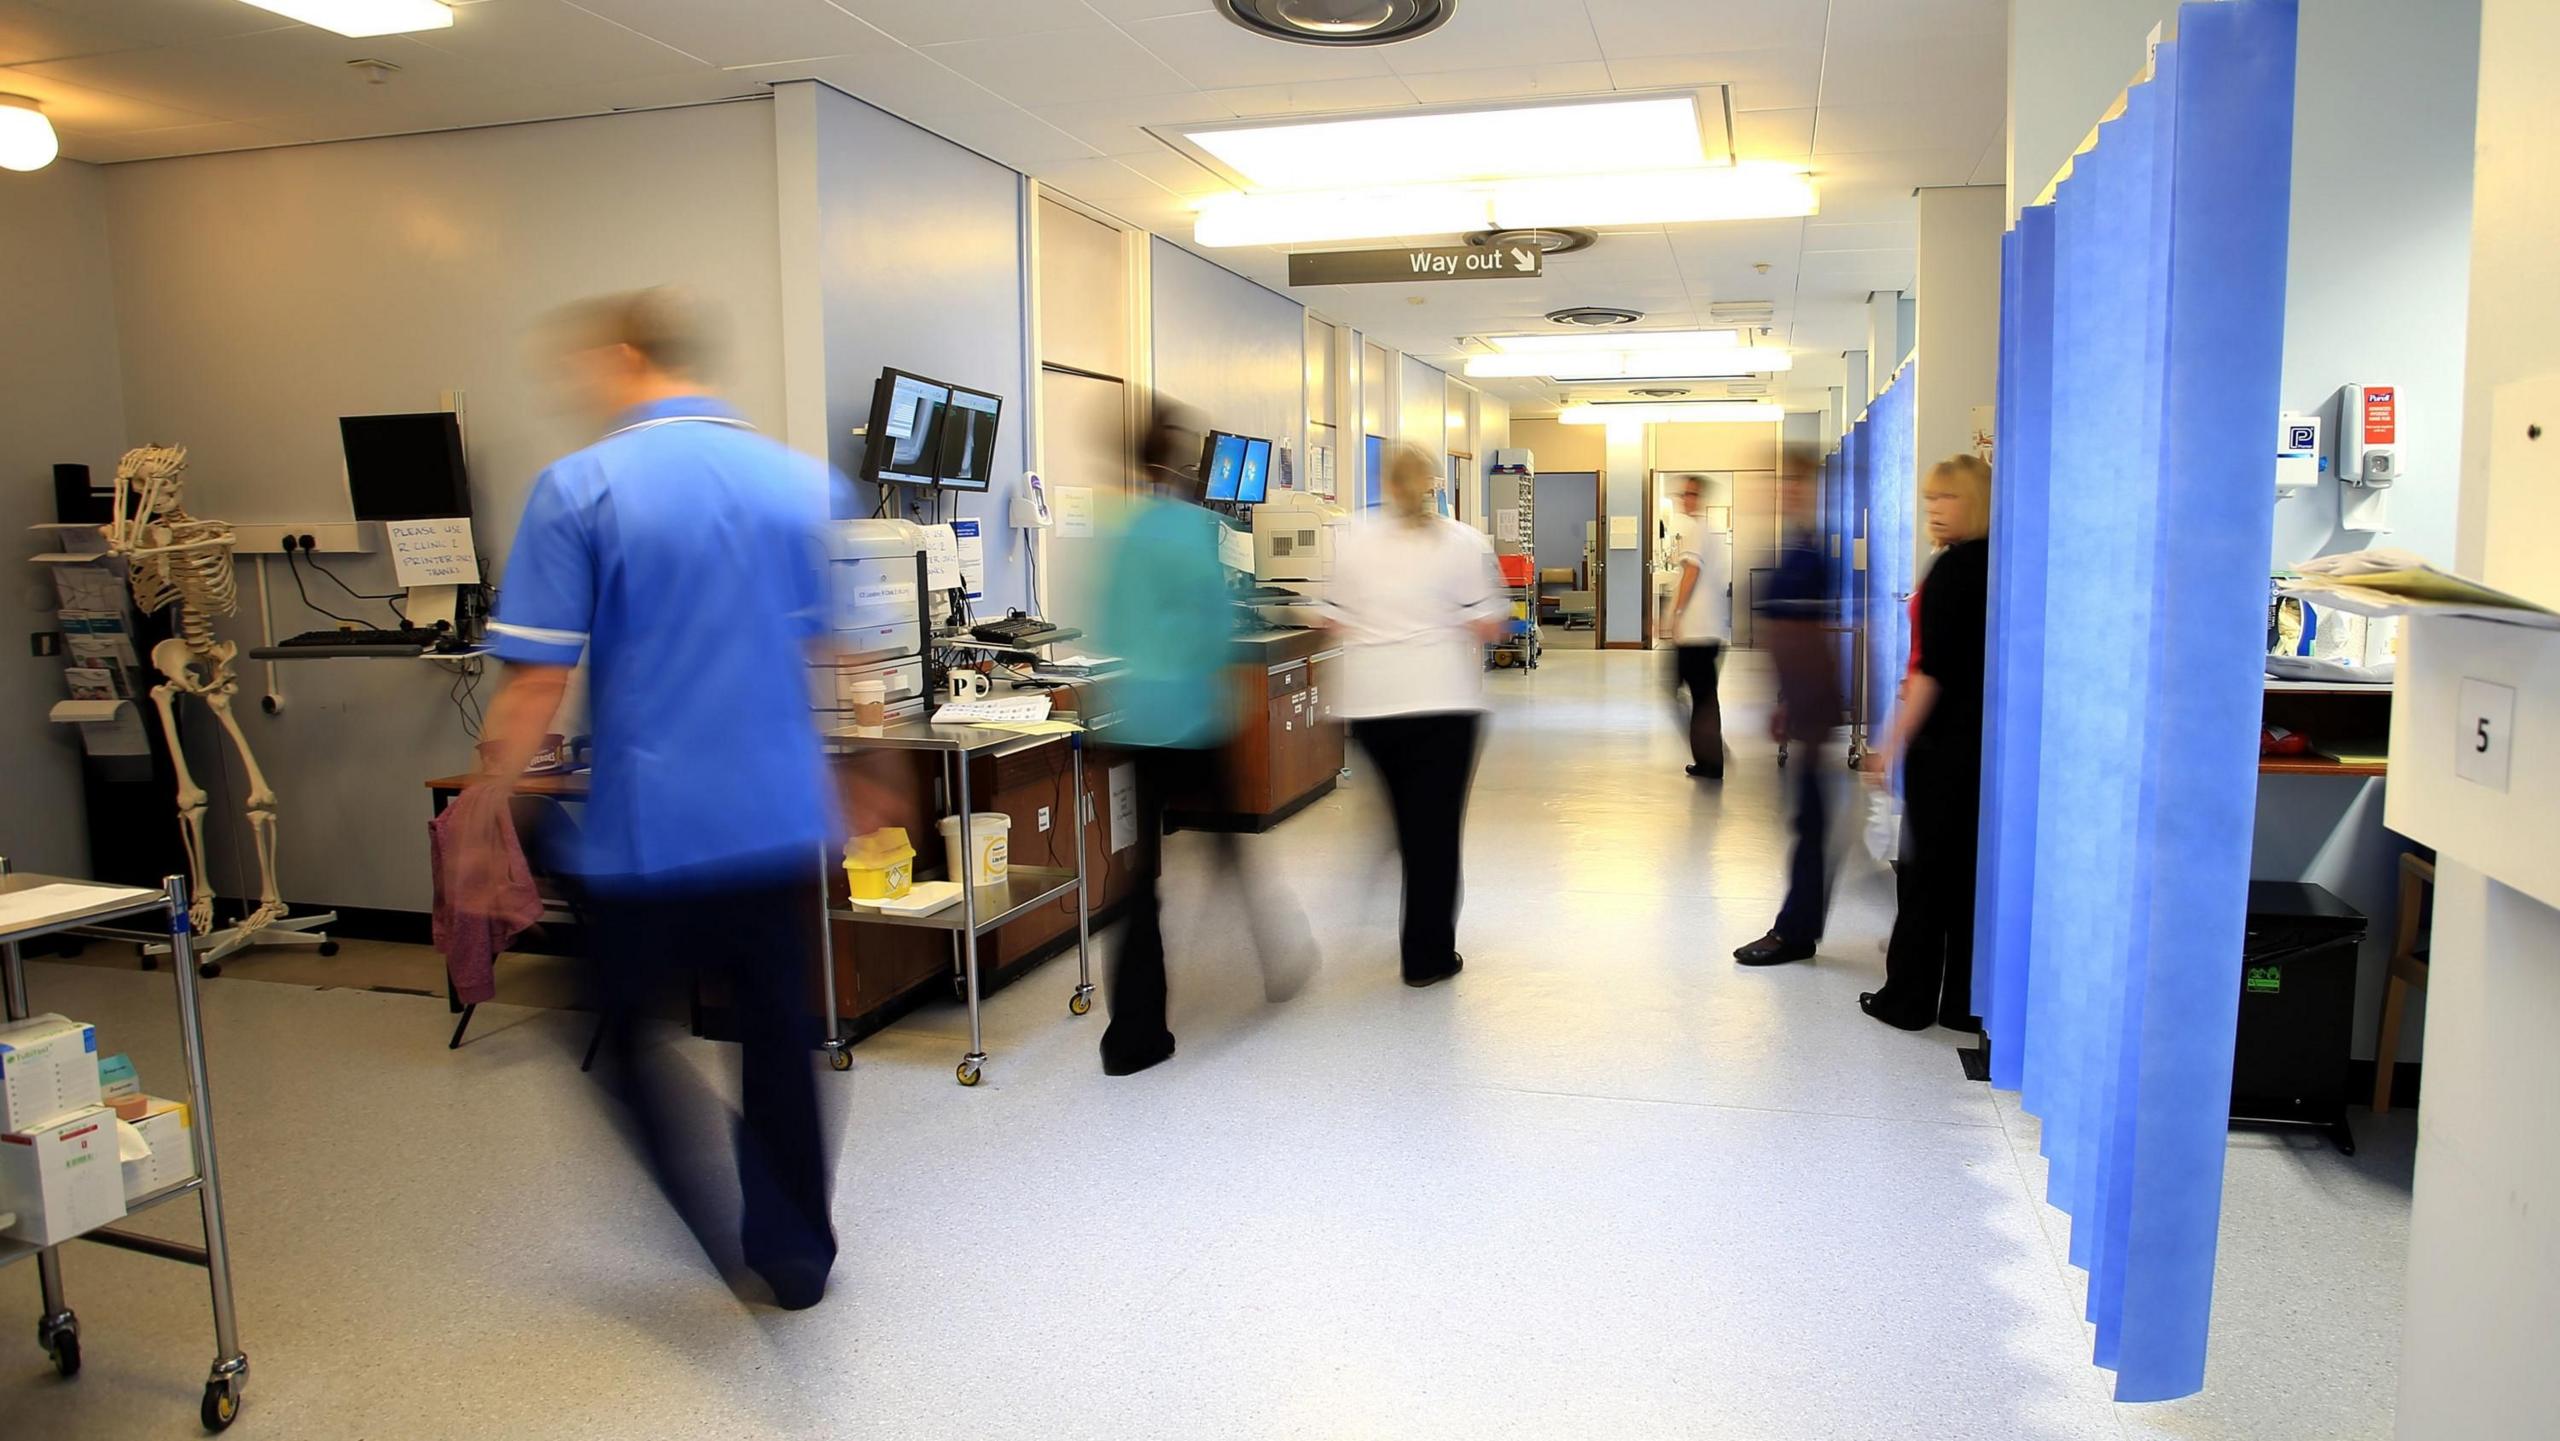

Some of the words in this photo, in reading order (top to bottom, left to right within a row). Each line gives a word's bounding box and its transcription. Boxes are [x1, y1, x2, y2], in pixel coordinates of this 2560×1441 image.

[1409, 252, 1459, 275] Way
[1465, 249, 1503, 270] out
[392, 527, 437, 538] PLEASE
[444, 525, 464, 534] USE
[402, 555, 454, 566] PRINTER
[953, 679, 968, 697] P
[2476, 717, 2490, 753] 5
